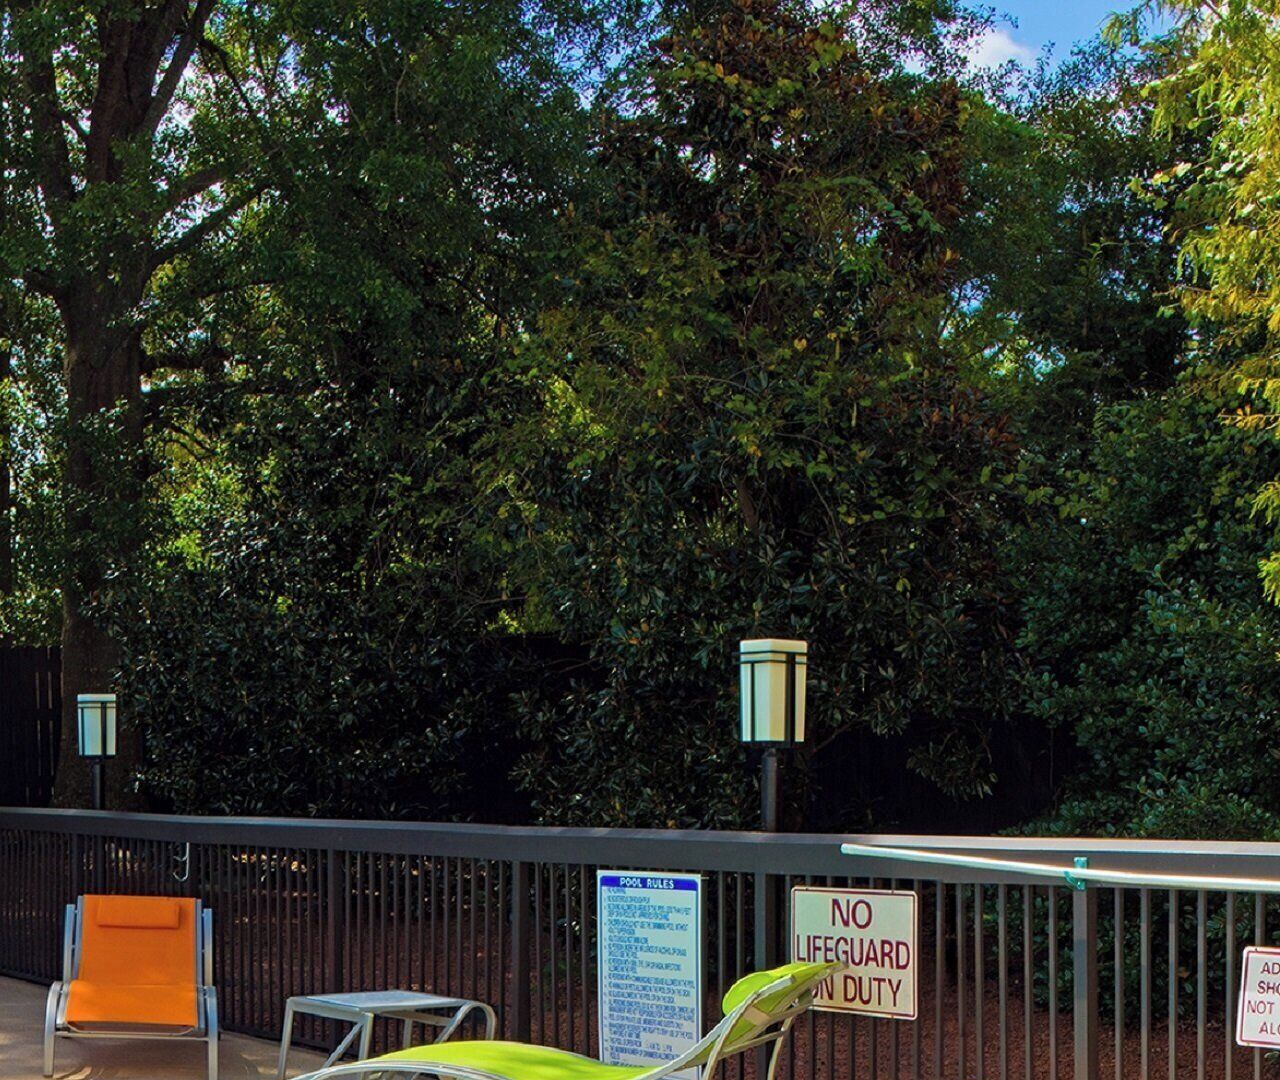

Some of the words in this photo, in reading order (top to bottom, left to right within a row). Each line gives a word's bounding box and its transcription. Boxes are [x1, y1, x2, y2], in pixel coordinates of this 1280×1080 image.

[620, 877, 642, 888] POOL
[646, 878, 674, 889] RULES
[831, 898, 873, 930] NO
[796, 934, 911, 970] LIFEGUARD
[843, 973, 902, 1008] DUTY
[1246, 1000, 1274, 1015] NOT
